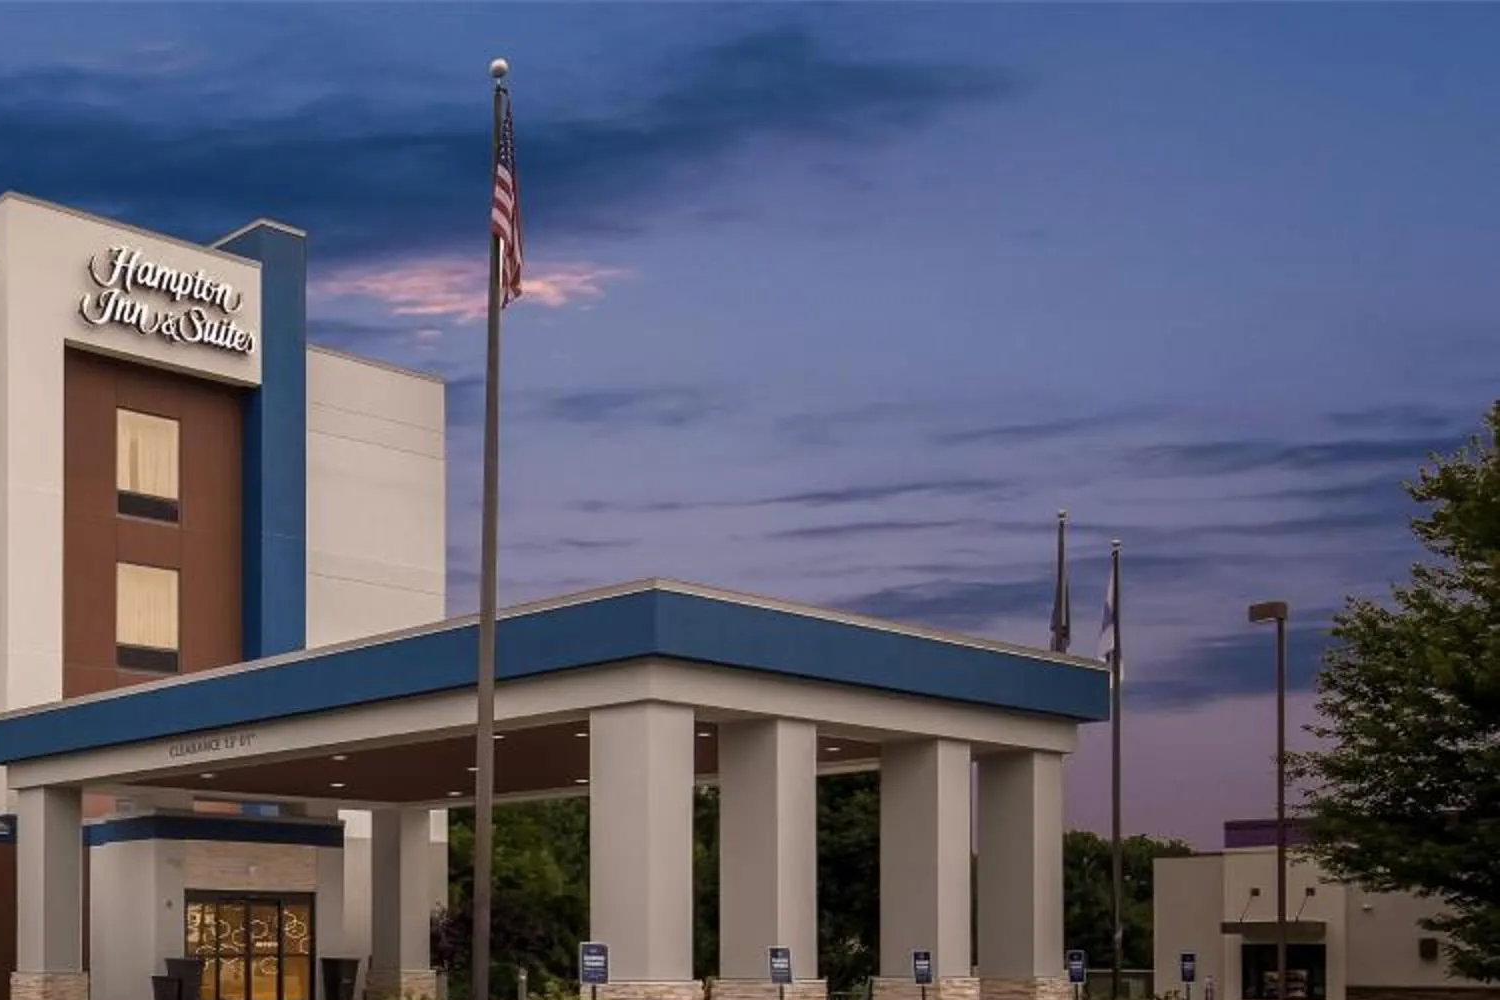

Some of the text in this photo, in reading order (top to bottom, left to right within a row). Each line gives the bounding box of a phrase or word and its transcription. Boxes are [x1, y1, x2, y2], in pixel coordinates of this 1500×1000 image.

[88, 246, 242, 314] Hampton
[79, 288, 256, 354] Inn & Suites
